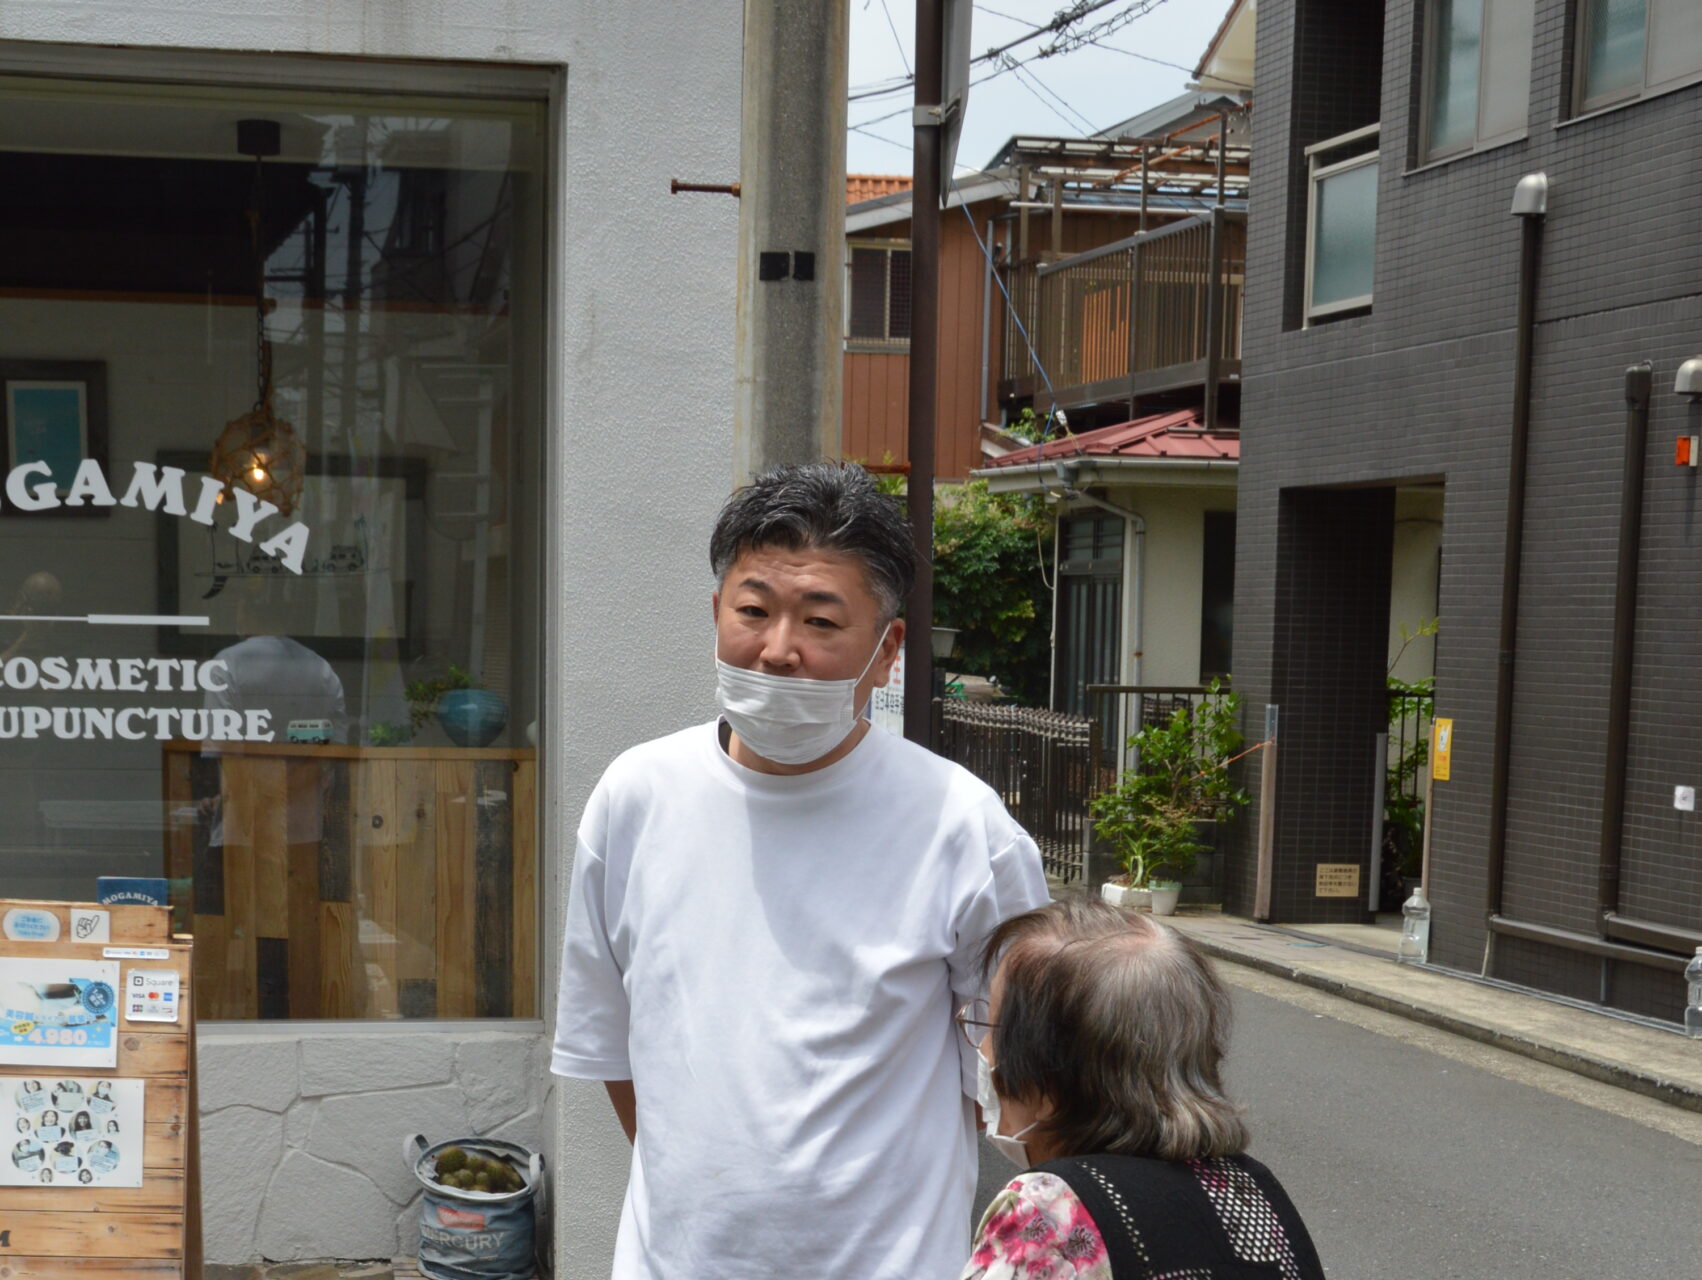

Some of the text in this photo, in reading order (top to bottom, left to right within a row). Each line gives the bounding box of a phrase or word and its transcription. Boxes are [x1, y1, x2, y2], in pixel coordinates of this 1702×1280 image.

[0, 458, 310, 576] GAMIYA
[0, 656, 229, 693] OSMETIC
[102, 892, 159, 906] MOGAMIYA
[145, 978, 174, 988] Square
